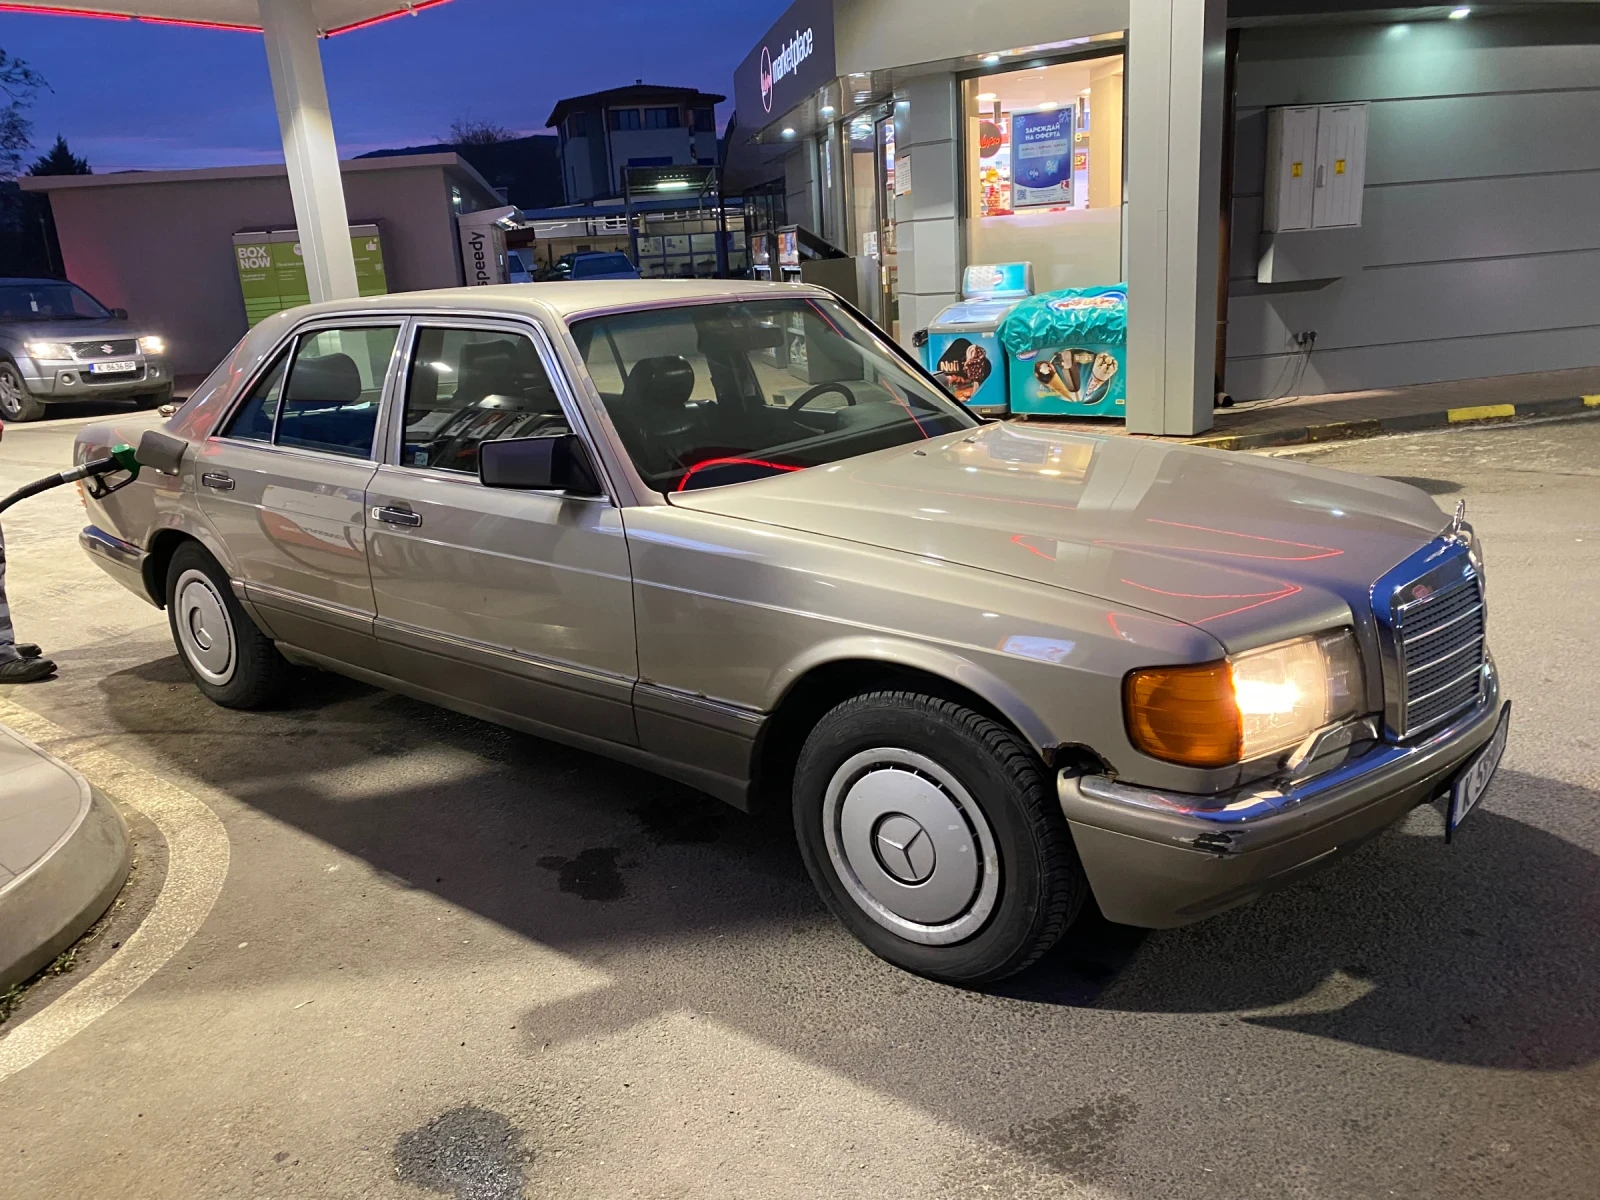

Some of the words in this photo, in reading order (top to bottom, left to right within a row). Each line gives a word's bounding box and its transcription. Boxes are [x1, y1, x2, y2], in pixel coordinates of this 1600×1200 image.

[772, 27, 813, 84] marketplace
[1025, 123, 1060, 134] ЗАРЕЖДАЙ
[1035, 130, 1060, 140] ОФЕРТА
[238, 246, 267, 259] BOX
[239, 257, 271, 269] NOW
